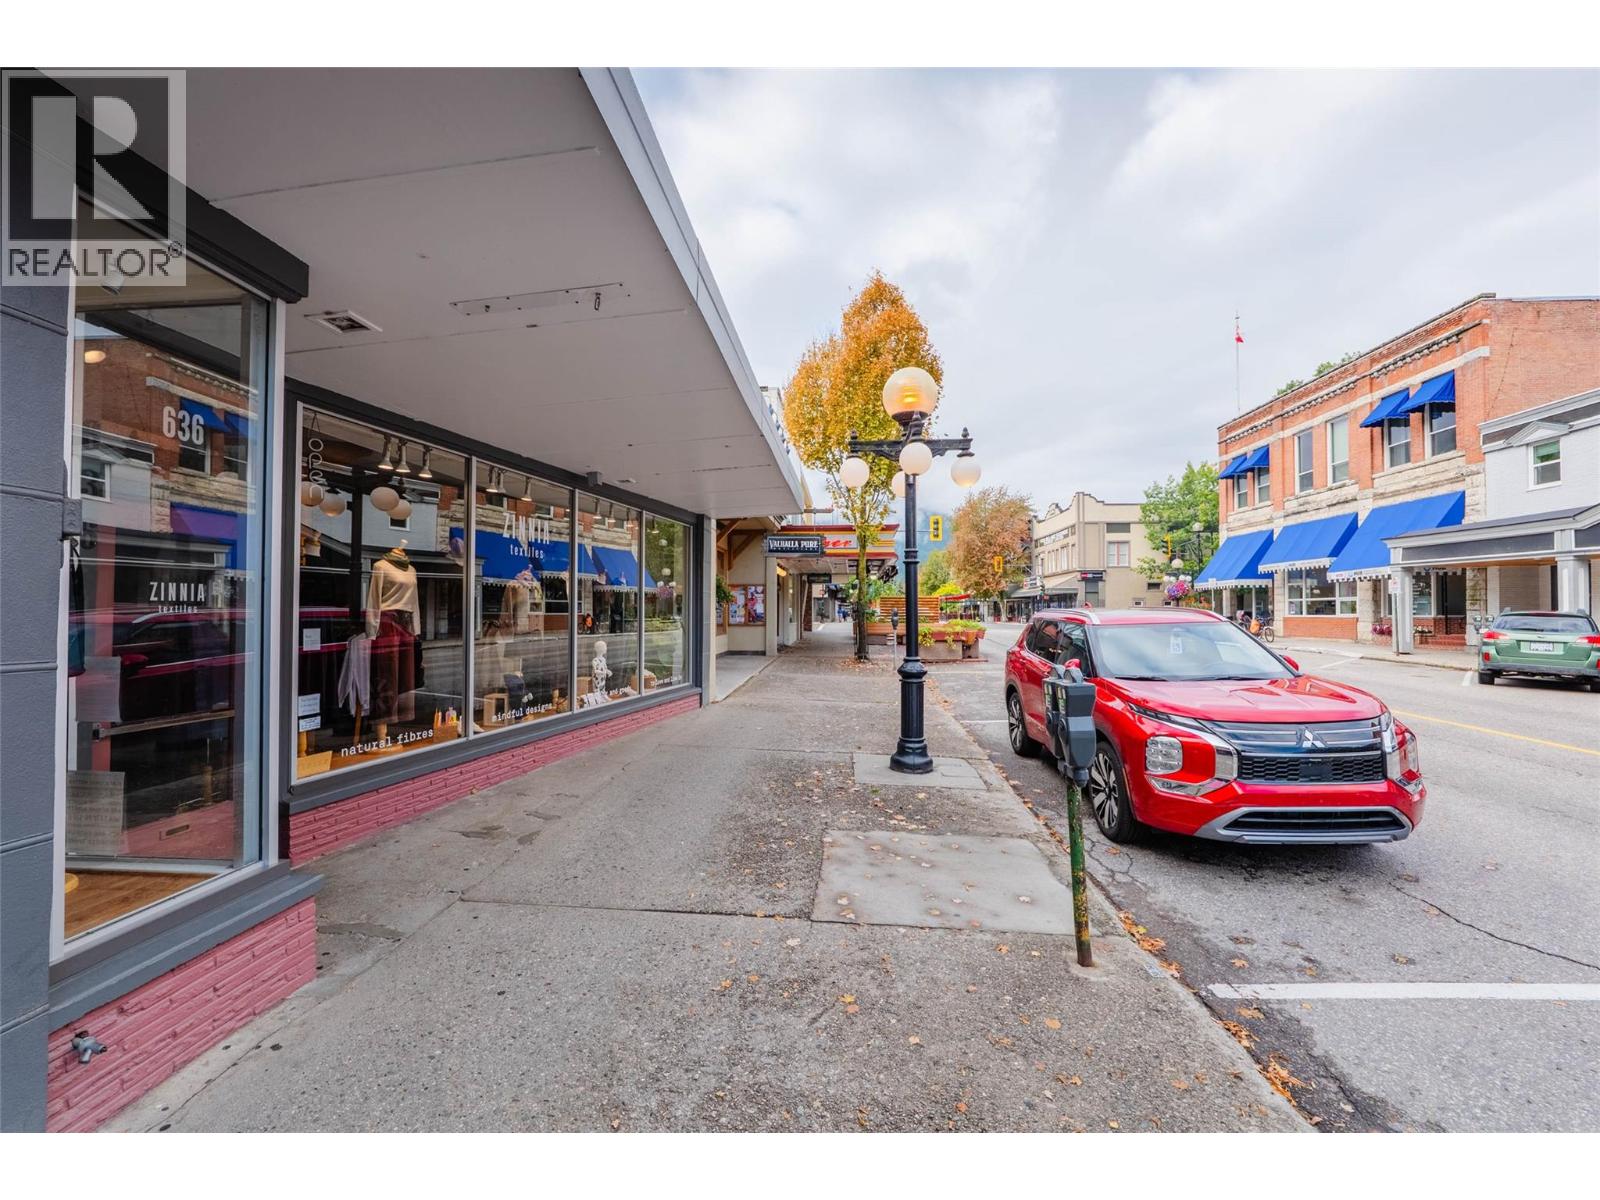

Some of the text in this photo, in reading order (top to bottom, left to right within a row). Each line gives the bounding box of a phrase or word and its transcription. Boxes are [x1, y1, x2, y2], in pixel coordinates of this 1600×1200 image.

[162, 406, 205, 445] 636
[308, 438, 324, 499] open
[503, 512, 550, 545] ZINNIA
[510, 544, 544, 559] textiles
[769, 540, 799, 550] VALHALLA
[800, 540, 819, 548] PURE
[150, 582, 205, 602] ZINNIA
[158, 604, 198, 614] textiles
[492, 708, 524, 722] mindful
[341, 729, 434, 757] natural fibres
